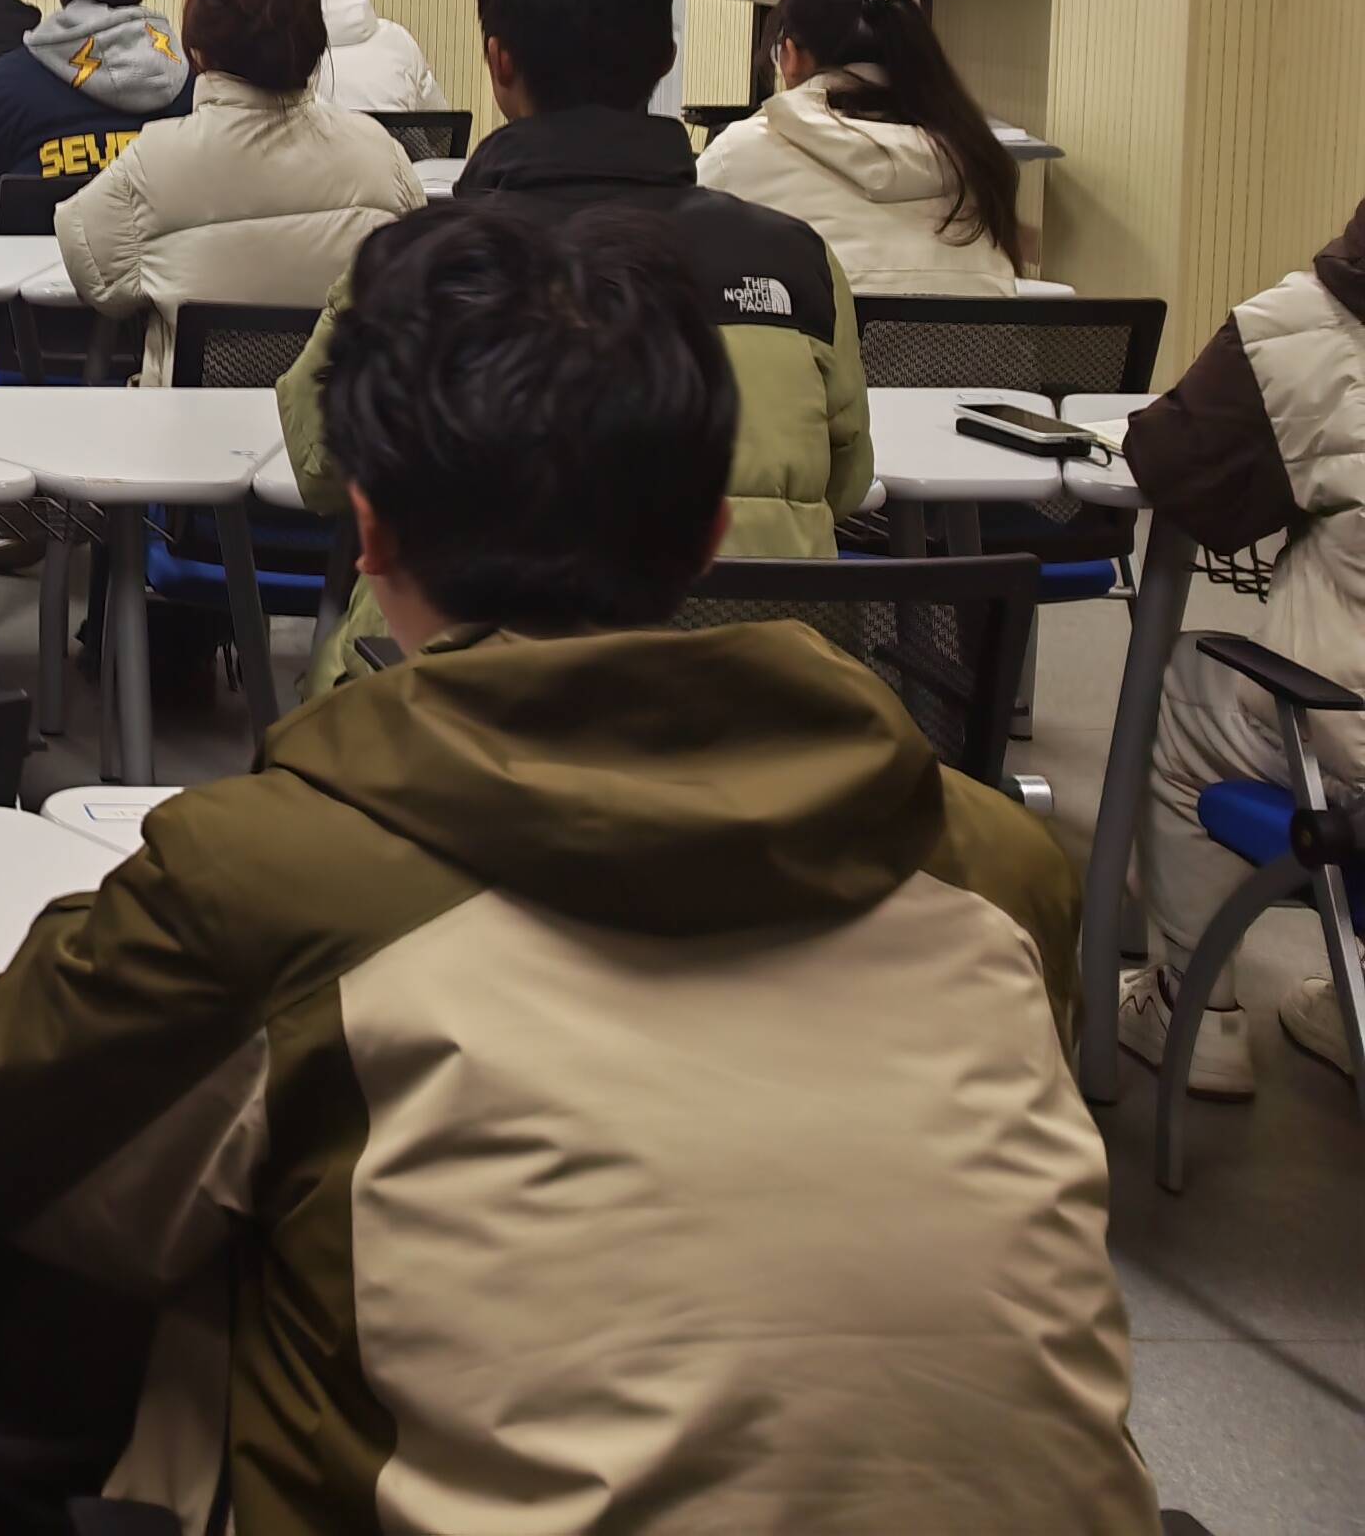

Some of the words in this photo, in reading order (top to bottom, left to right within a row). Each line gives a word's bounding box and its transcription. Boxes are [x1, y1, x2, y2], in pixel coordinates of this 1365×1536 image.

[741, 276, 770, 290] THE
[724, 287, 771, 303] NORTH
[739, 298, 773, 314] FACE
